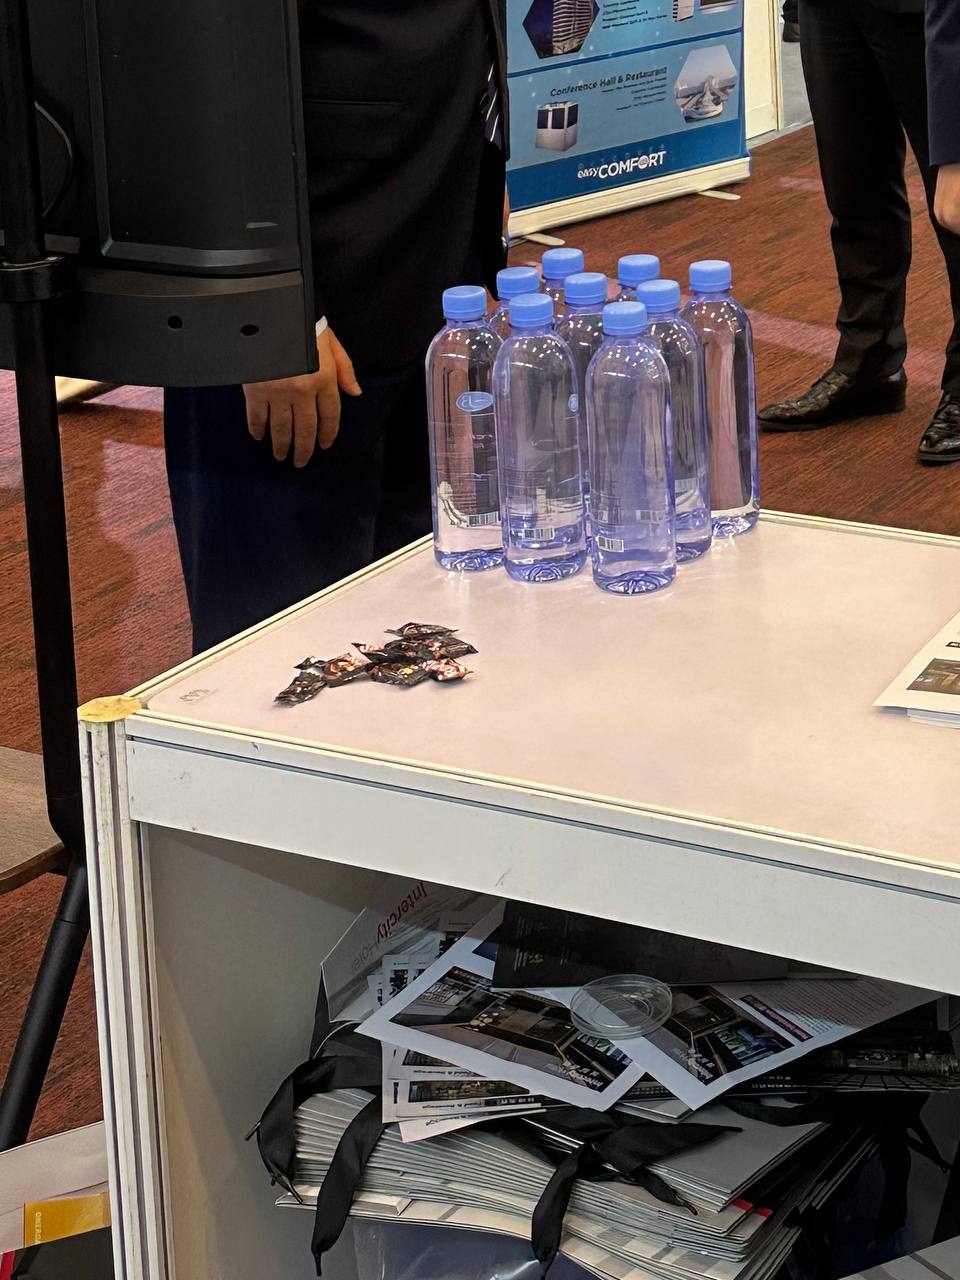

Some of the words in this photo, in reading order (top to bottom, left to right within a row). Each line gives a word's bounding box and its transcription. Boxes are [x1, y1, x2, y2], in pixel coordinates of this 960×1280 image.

[550, 82, 599, 97] Conference
[599, 76, 617, 88] Hall
[377, 881, 427, 944] Intercity
